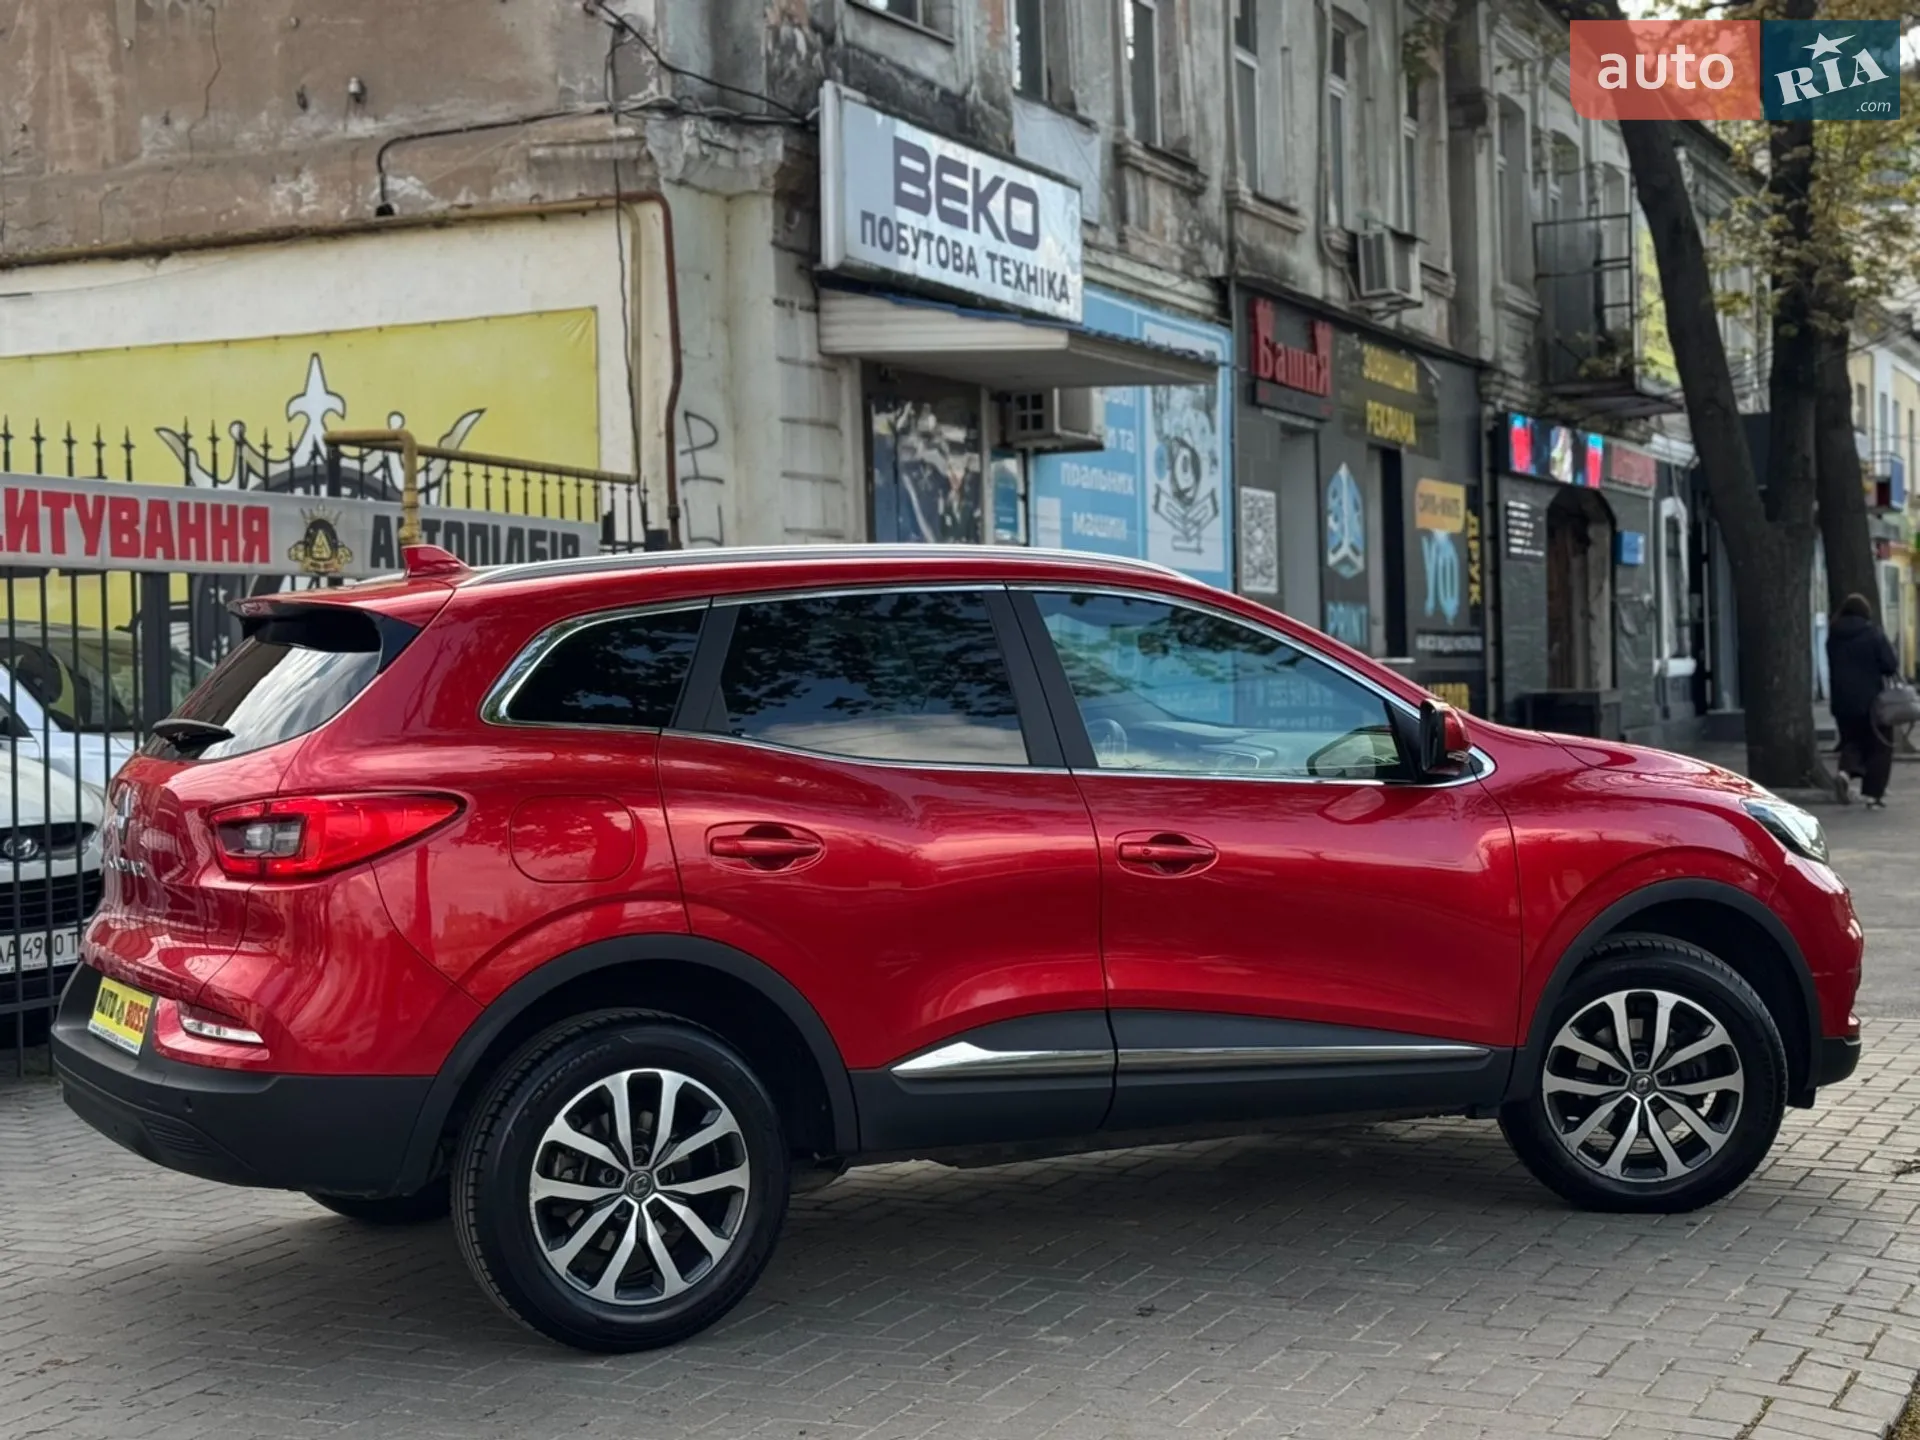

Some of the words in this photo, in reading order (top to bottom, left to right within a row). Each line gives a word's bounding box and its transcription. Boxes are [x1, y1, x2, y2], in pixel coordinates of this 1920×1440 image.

[893, 136, 1040, 251] BEKO
[861, 210, 979, 279] ПОБУТОВА
[986, 251, 1070, 305] ТЕХНІКА
[0, 487, 270, 564] ИТУВАННЯ
[370, 514, 580, 570] АТОПІДБІР
